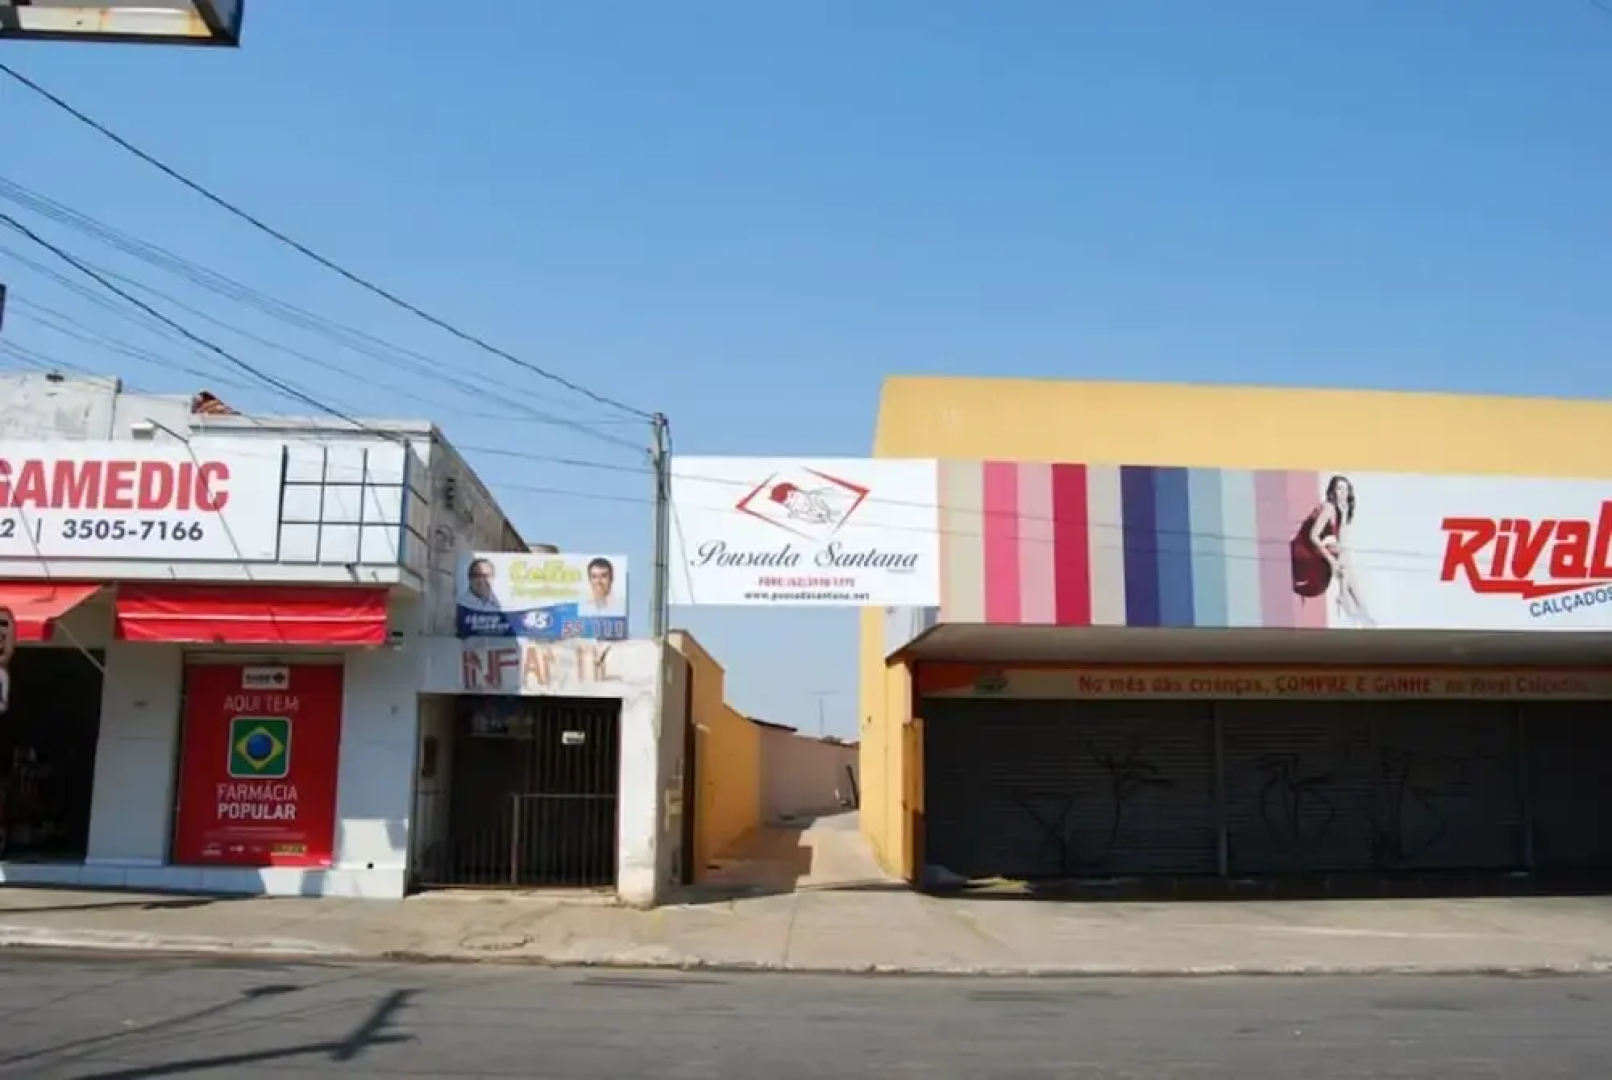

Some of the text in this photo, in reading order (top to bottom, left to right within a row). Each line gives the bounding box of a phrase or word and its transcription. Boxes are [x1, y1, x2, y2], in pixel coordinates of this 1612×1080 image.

[62, 519, 204, 541] 3505-7166
[690, 540, 918, 568] Pousada Santana
[1356, 676, 1367, 693] E
[224, 695, 299, 712] AQUI TEM
[216, 781, 299, 801] FARMÁCIA
[217, 802, 296, 820] POPULAR
